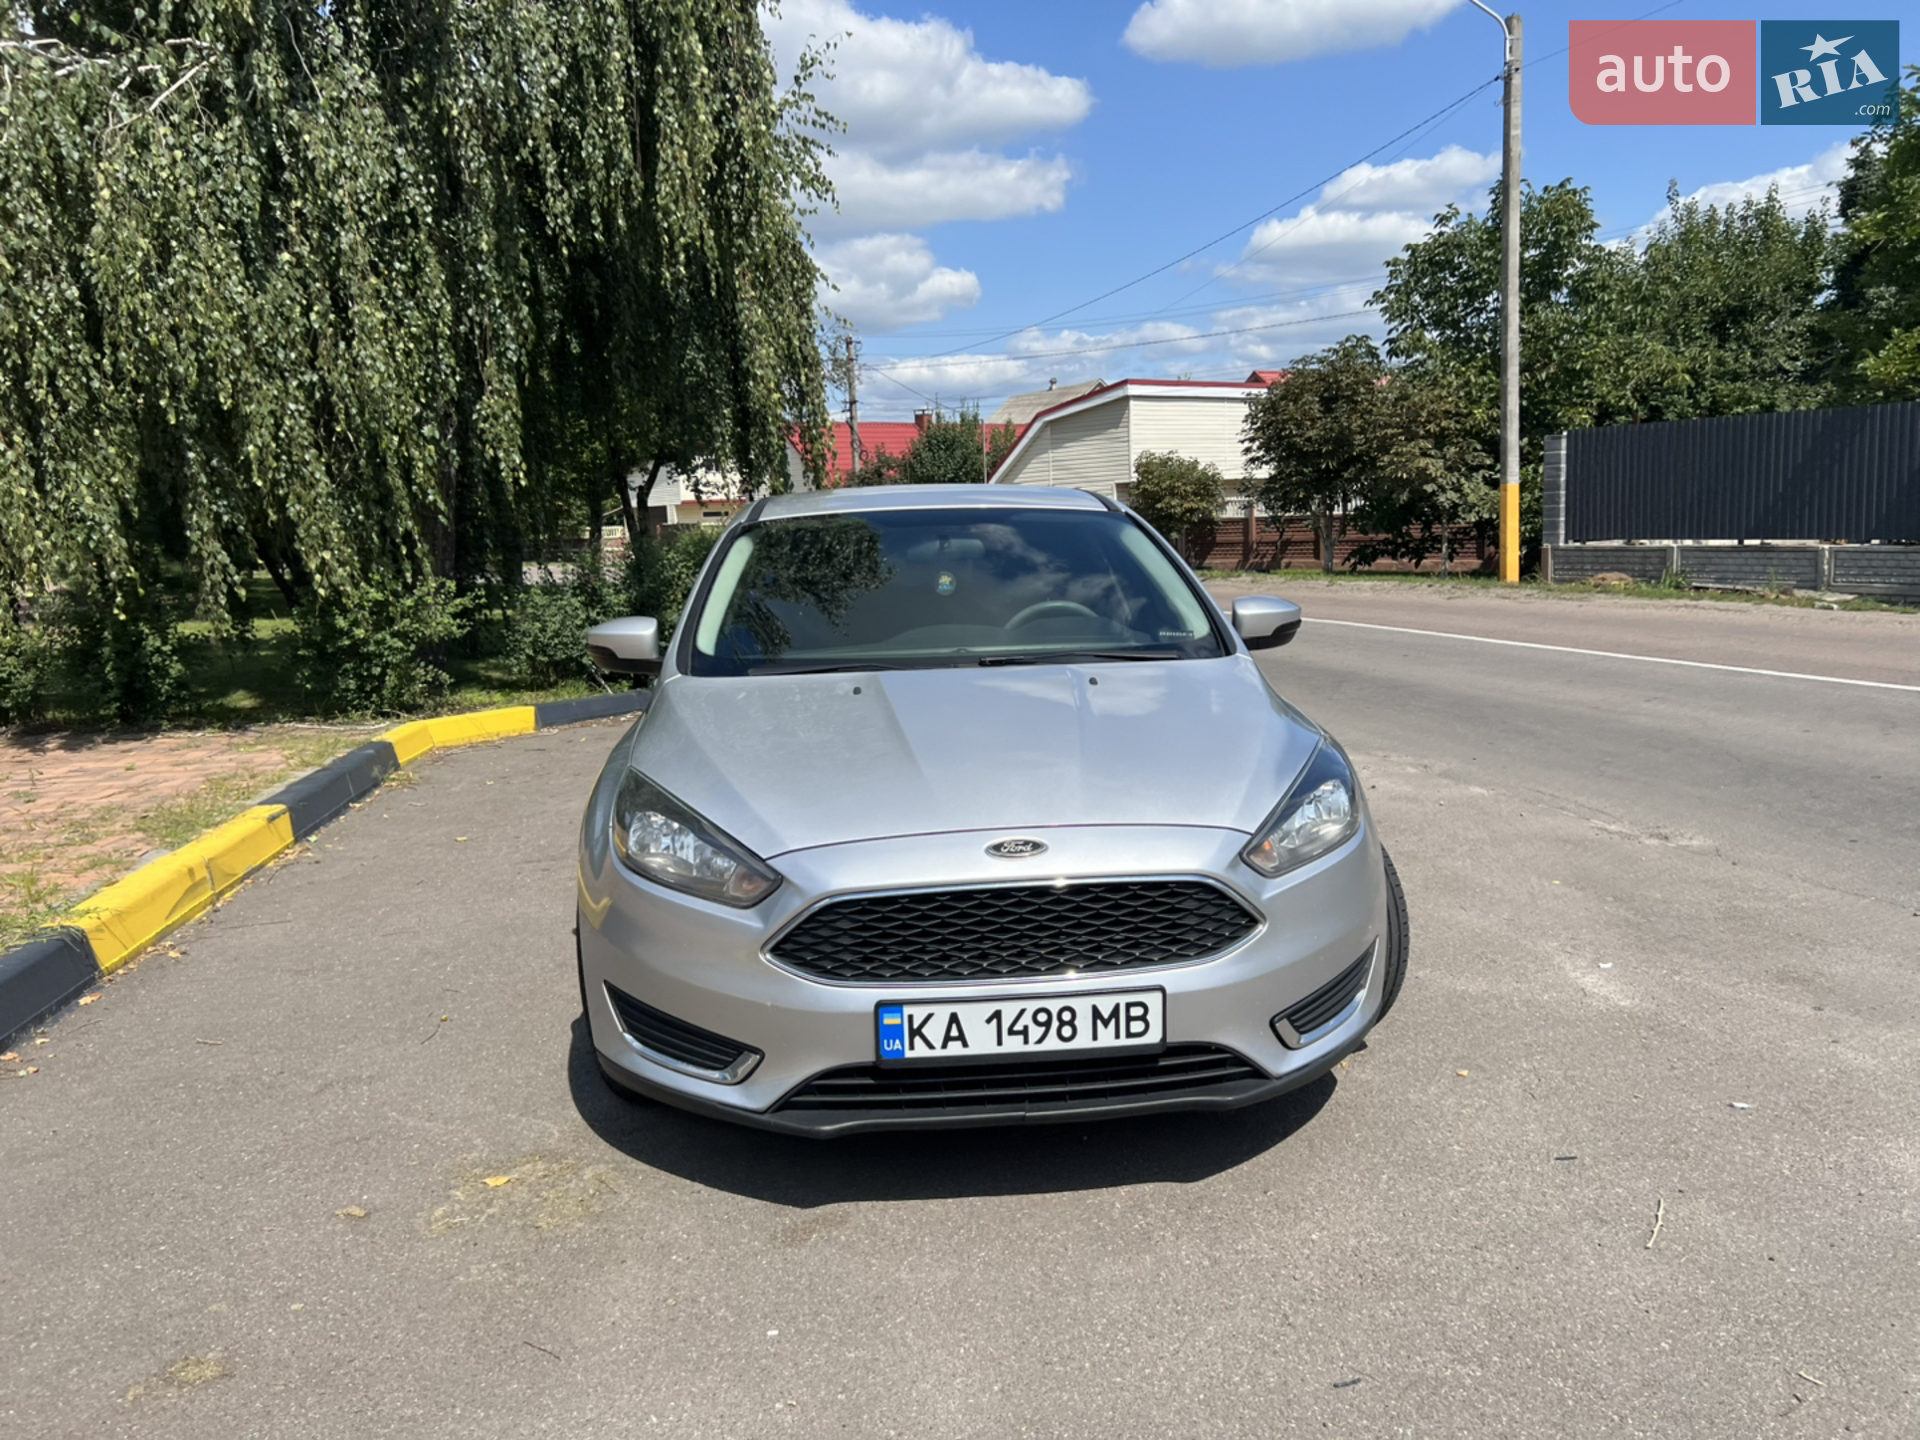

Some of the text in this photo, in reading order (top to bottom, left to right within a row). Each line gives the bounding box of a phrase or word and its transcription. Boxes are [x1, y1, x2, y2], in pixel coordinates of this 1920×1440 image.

[1000, 840, 1033, 853] Ford
[907, 1001, 1151, 1051] KA 1498 MB
[883, 1039, 903, 1051] UA
